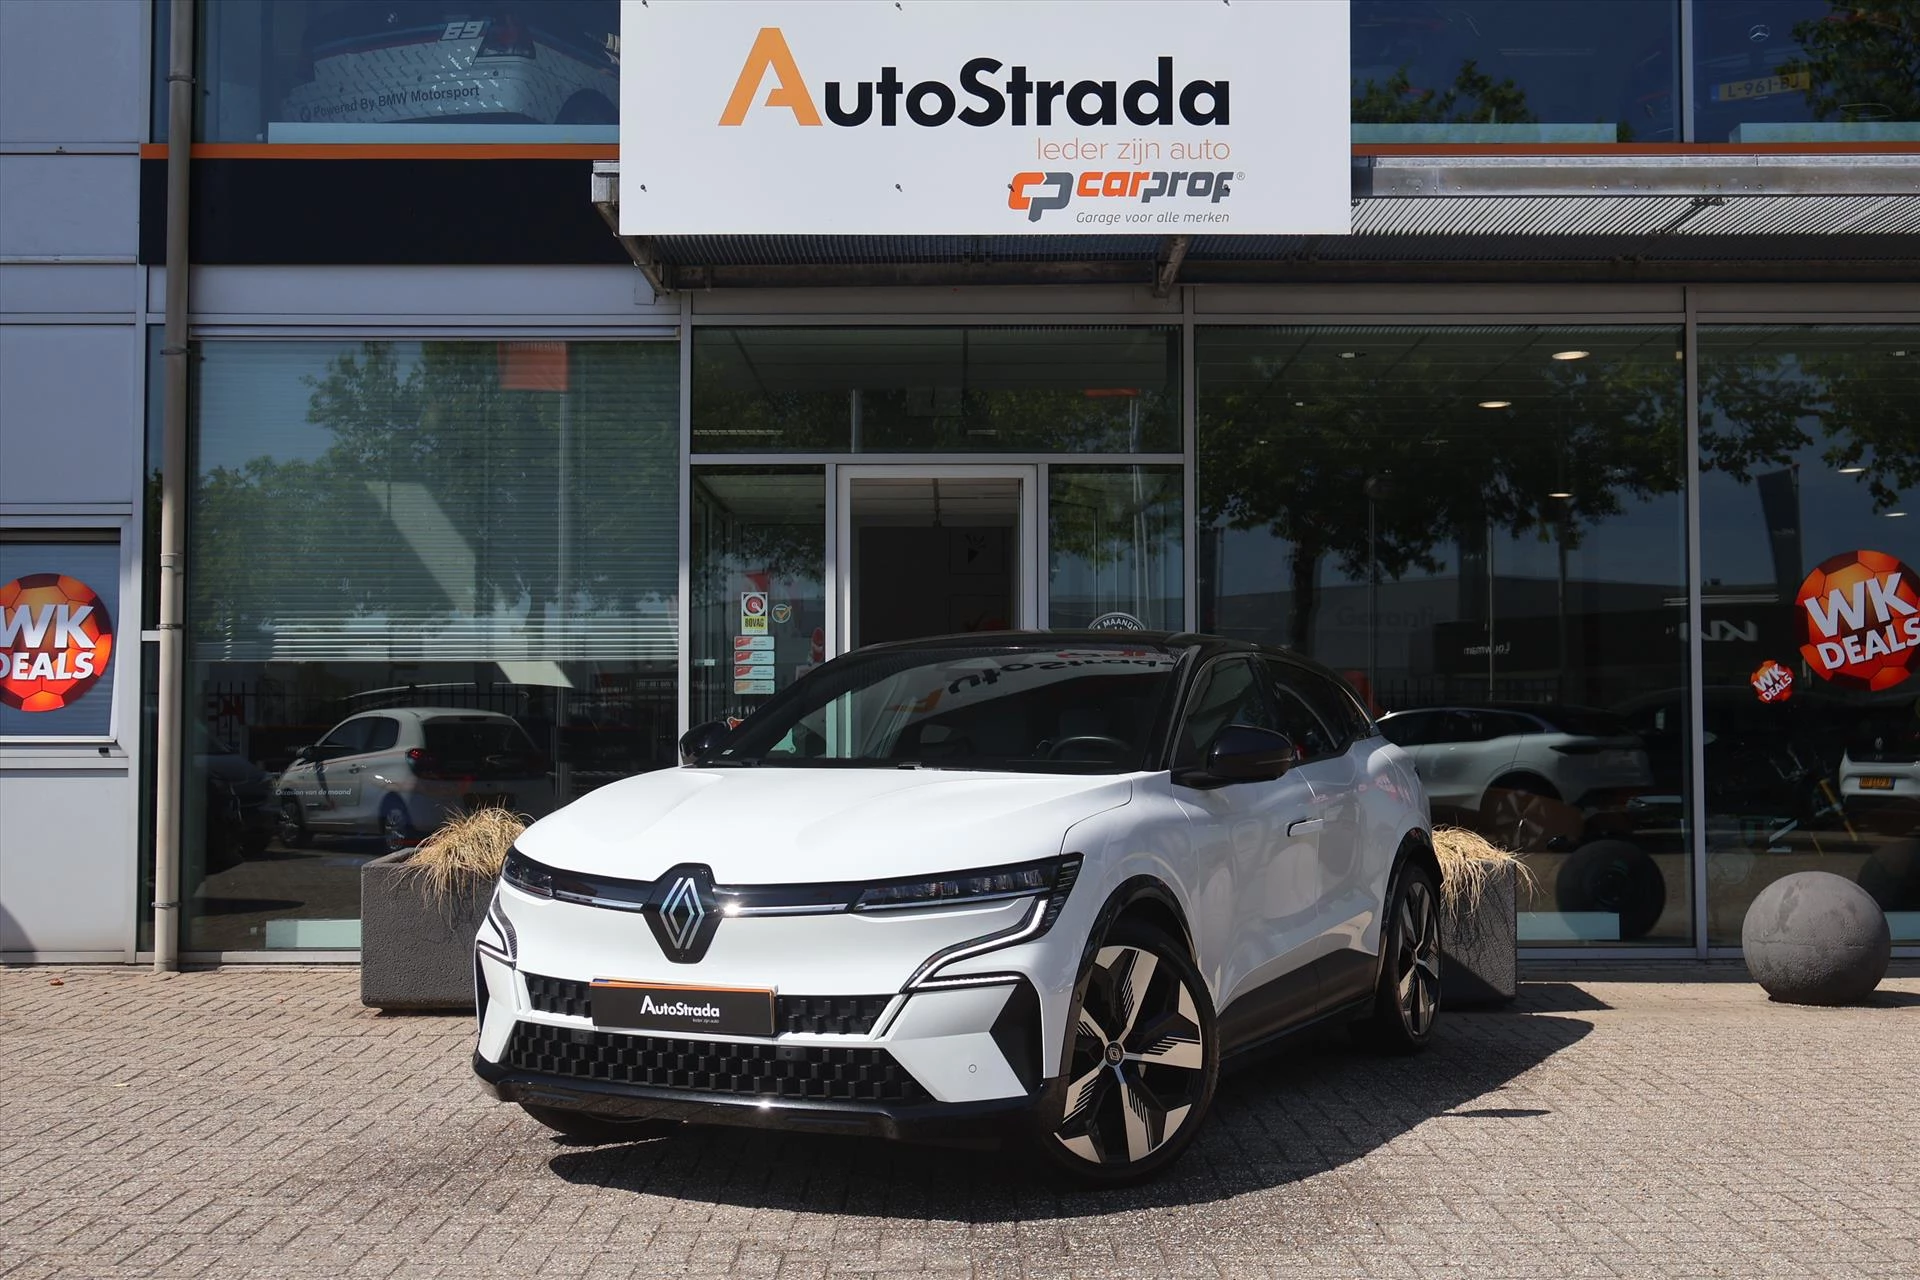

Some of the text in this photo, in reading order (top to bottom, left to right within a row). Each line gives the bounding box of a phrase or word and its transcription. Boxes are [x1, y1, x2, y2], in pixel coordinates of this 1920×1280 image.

[442, 21, 484, 40] 69
[718, 27, 1230, 128] AutoStrada
[313, 84, 480, 117] Powered By BMW Motorsport
[1036, 137, 1231, 166] Ieder zijn auto
[1076, 211, 1230, 226] Garage voor alle merken
[1804, 572, 1918, 638] WK
[0, 604, 96, 648] WK
[1816, 617, 1920, 670] DEALS
[1753, 663, 1786, 692] WK
[1762, 674, 1792, 701] DEALS
[317, 788, 326, 796] de
[327, 788, 352, 796] maand
[640, 995, 720, 1018] AutoStrada
